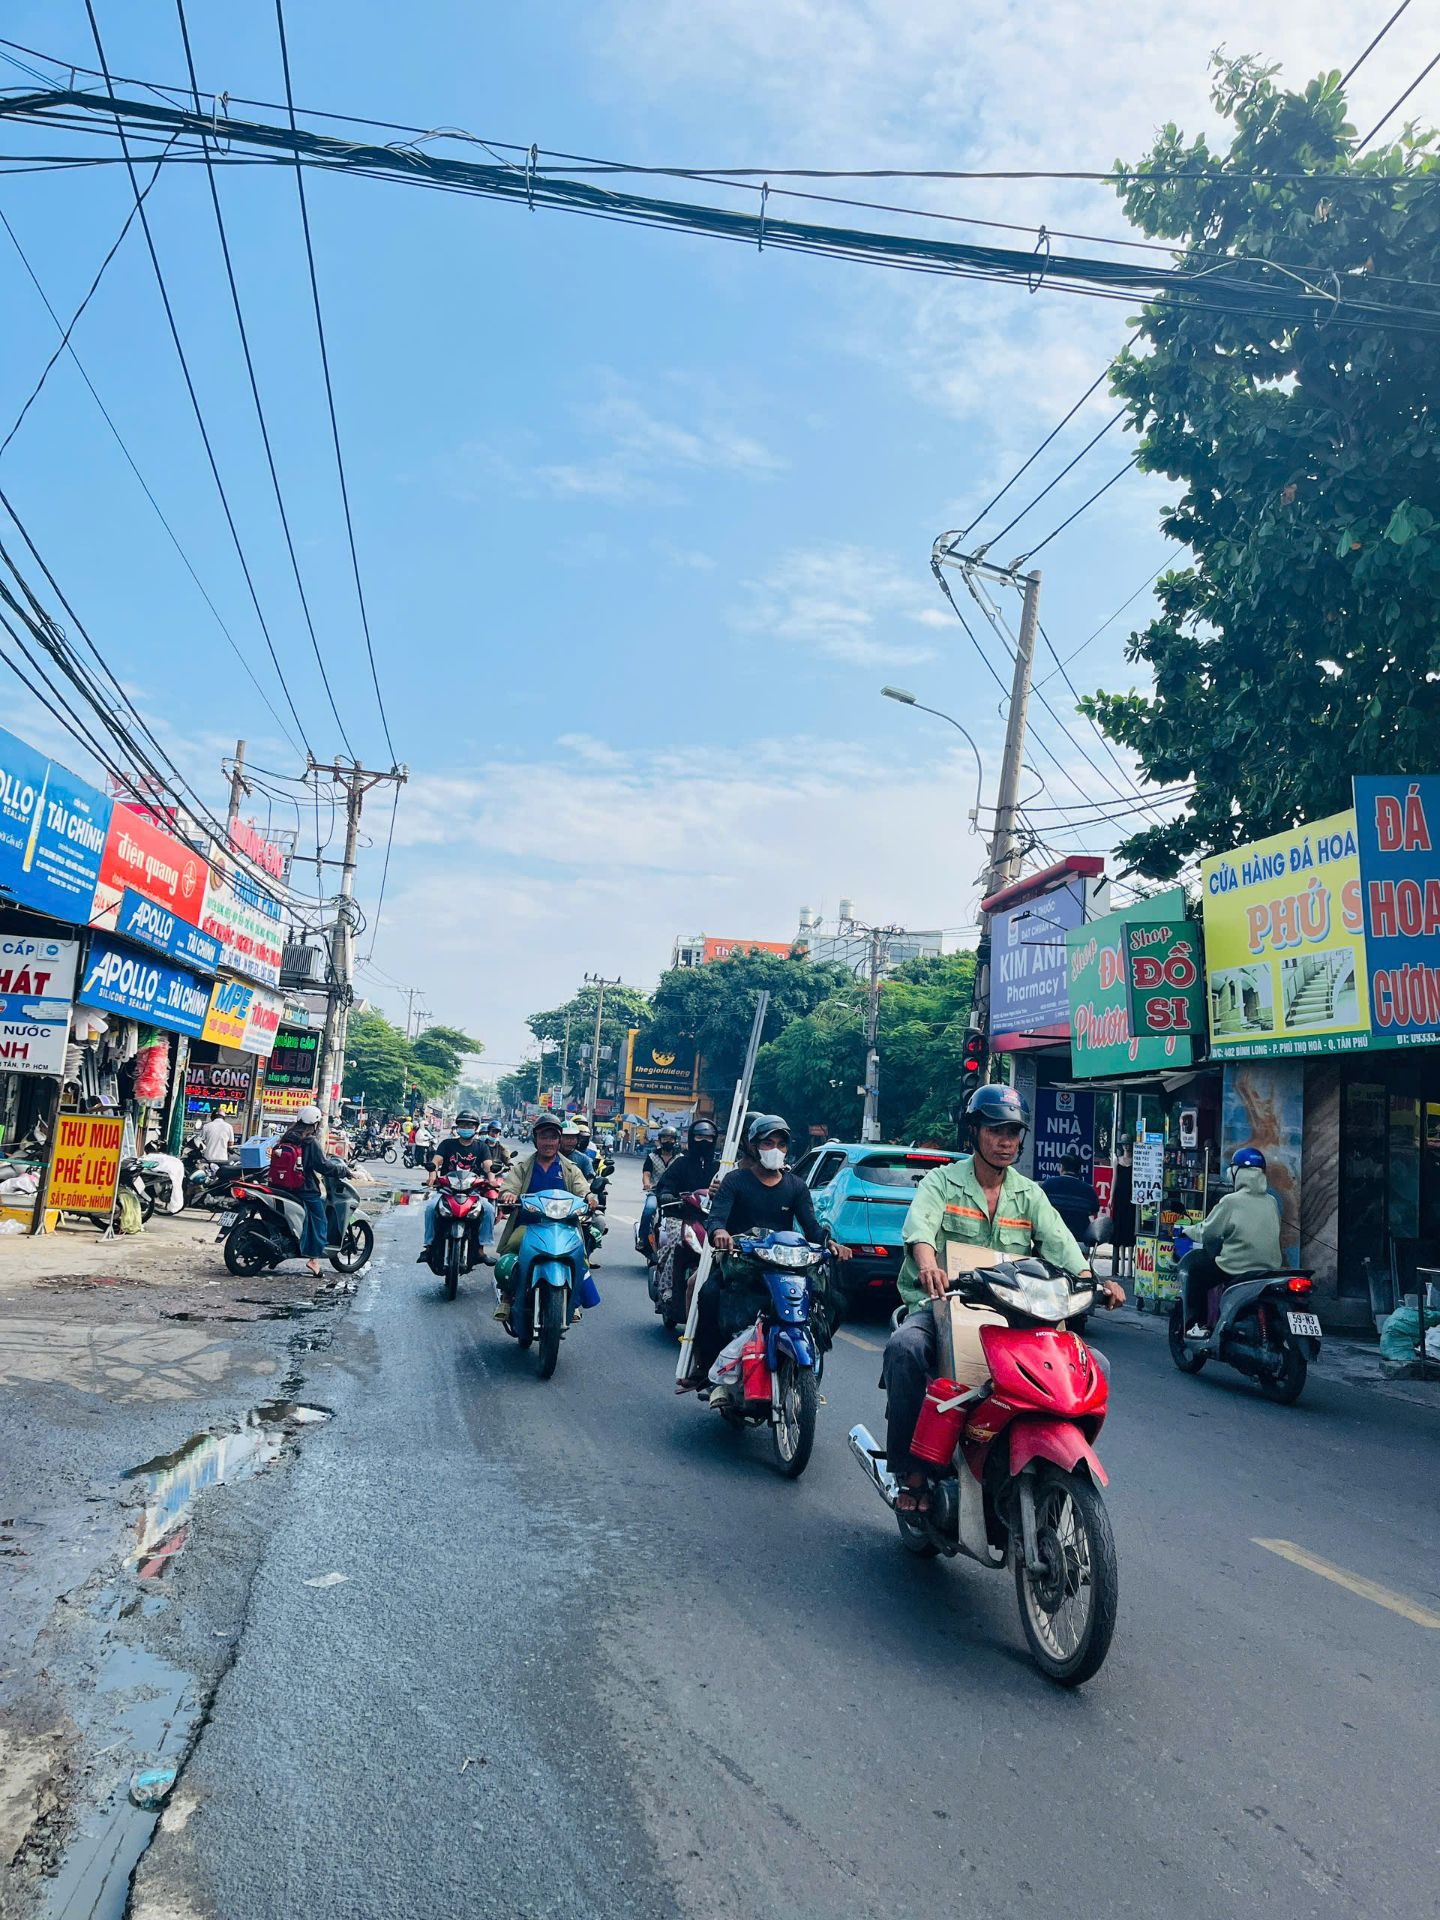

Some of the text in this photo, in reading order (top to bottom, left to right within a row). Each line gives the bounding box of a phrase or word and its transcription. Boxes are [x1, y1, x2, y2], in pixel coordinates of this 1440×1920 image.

[47, 800, 69, 835] TÀI
[67, 815, 105, 854] CHÍNH
[1374, 783, 1433, 853] ĐÁ
[116, 831, 145, 869] điện
[145, 854, 179, 896] quang
[1209, 830, 1358, 896] CỬA HÀNG ĐÁ HOA
[127, 901, 173, 941] APOLLO
[1247, 876, 1331, 955] PHÚ
[1368, 878, 1440, 938] HOA
[3, 939, 35, 956] CẤP
[1130, 925, 1173, 951] Shop
[1000, 933, 1067, 984] KIM ANH
[1071, 937, 1097, 983] Shop
[1132, 940, 1197, 992] ĐỒ
[84, 951, 158, 1002] APOLLO
[1006, 976, 1059, 1004] Pharmacy
[99, 988, 126, 1004] SILICONE
[128, 997, 153, 1012] SEALANT
[168, 976, 208, 1018] TÀI CHÍNH
[1145, 997, 1191, 1032] SI
[3, 1025, 52, 1038] NƯỚC
[1251, 1045, 1268, 1055] LONG
[1272, 1043, 1279, 1054] P.
[1279, 1040, 1293, 1053] PHÚ
[1294, 1041, 1308, 1054] THỌ
[1328, 1039, 1336, 1051] Q.
[1336, 1036, 1352, 1049] TÂN
[1352, 1033, 1369, 1048] PHÚ
[270, 1050, 312, 1072] LED
[211, 1069, 250, 1088] CÔNG
[286, 1091, 310, 1099] MUA
[61, 1121, 120, 1149] THU MUA
[1046, 1113, 1083, 1136] NHÀ
[1035, 1136, 1093, 1161] THUỐC
[53, 1152, 116, 1191] PHẾ LIỆU
[1038, 1161, 1063, 1172] KIM
[1136, 1247, 1154, 1272] Mía
[991, 1398, 1012, 1411] HONDA
